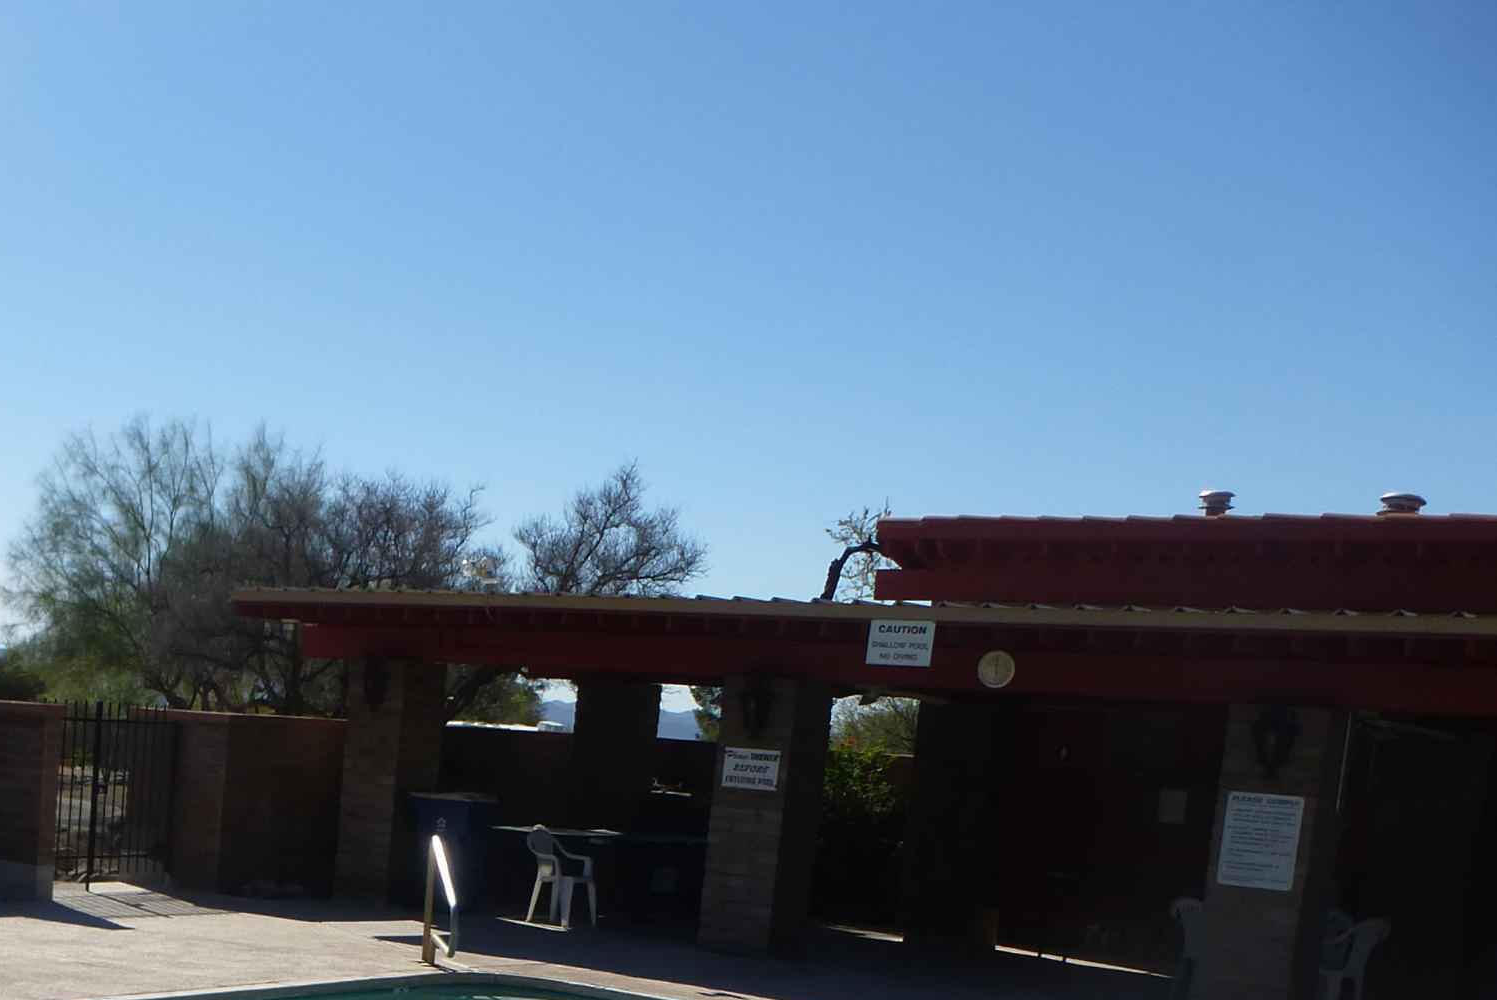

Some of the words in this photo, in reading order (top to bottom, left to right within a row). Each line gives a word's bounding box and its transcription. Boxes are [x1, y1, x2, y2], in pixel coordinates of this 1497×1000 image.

[878, 624, 927, 635] CAUTION
[871, 641, 906, 650] SHALLOW
[908, 642, 929, 651] POOL
[879, 653, 890, 661] NO
[892, 653, 918, 662] DIVING
[732, 763, 769, 774] BEFORE
[1232, 795, 1264, 804] PLEASE
[1266, 798, 1300, 806] COMPLY
